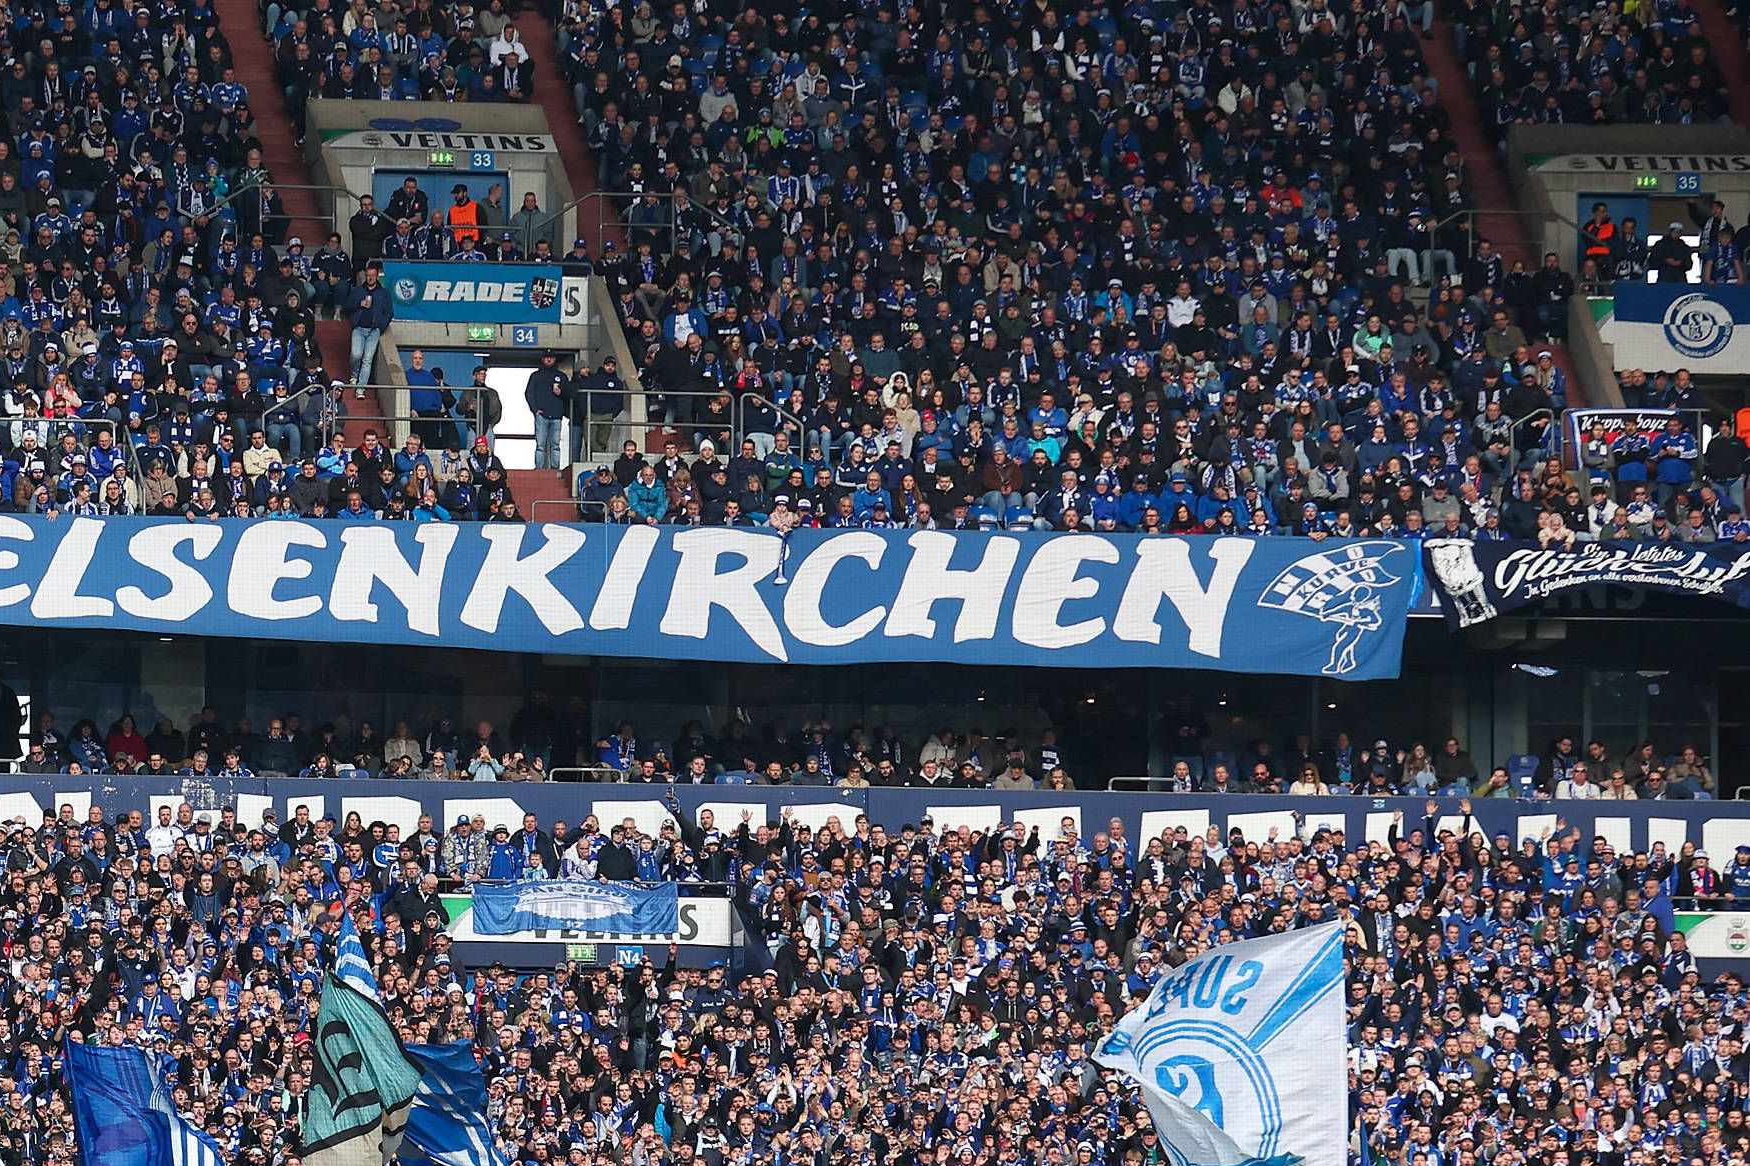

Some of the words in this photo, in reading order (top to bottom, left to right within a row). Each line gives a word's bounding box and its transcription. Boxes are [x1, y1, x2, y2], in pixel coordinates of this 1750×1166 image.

[385, 133, 545, 150] VELTINS
[473, 153, 491, 166] 33
[1596, 155, 1750, 171] VELTINS
[1679, 176, 1697, 189] 35
[422, 280, 526, 303] RADE
[516, 329, 534, 342] 34
[619, 951, 641, 965] N4
